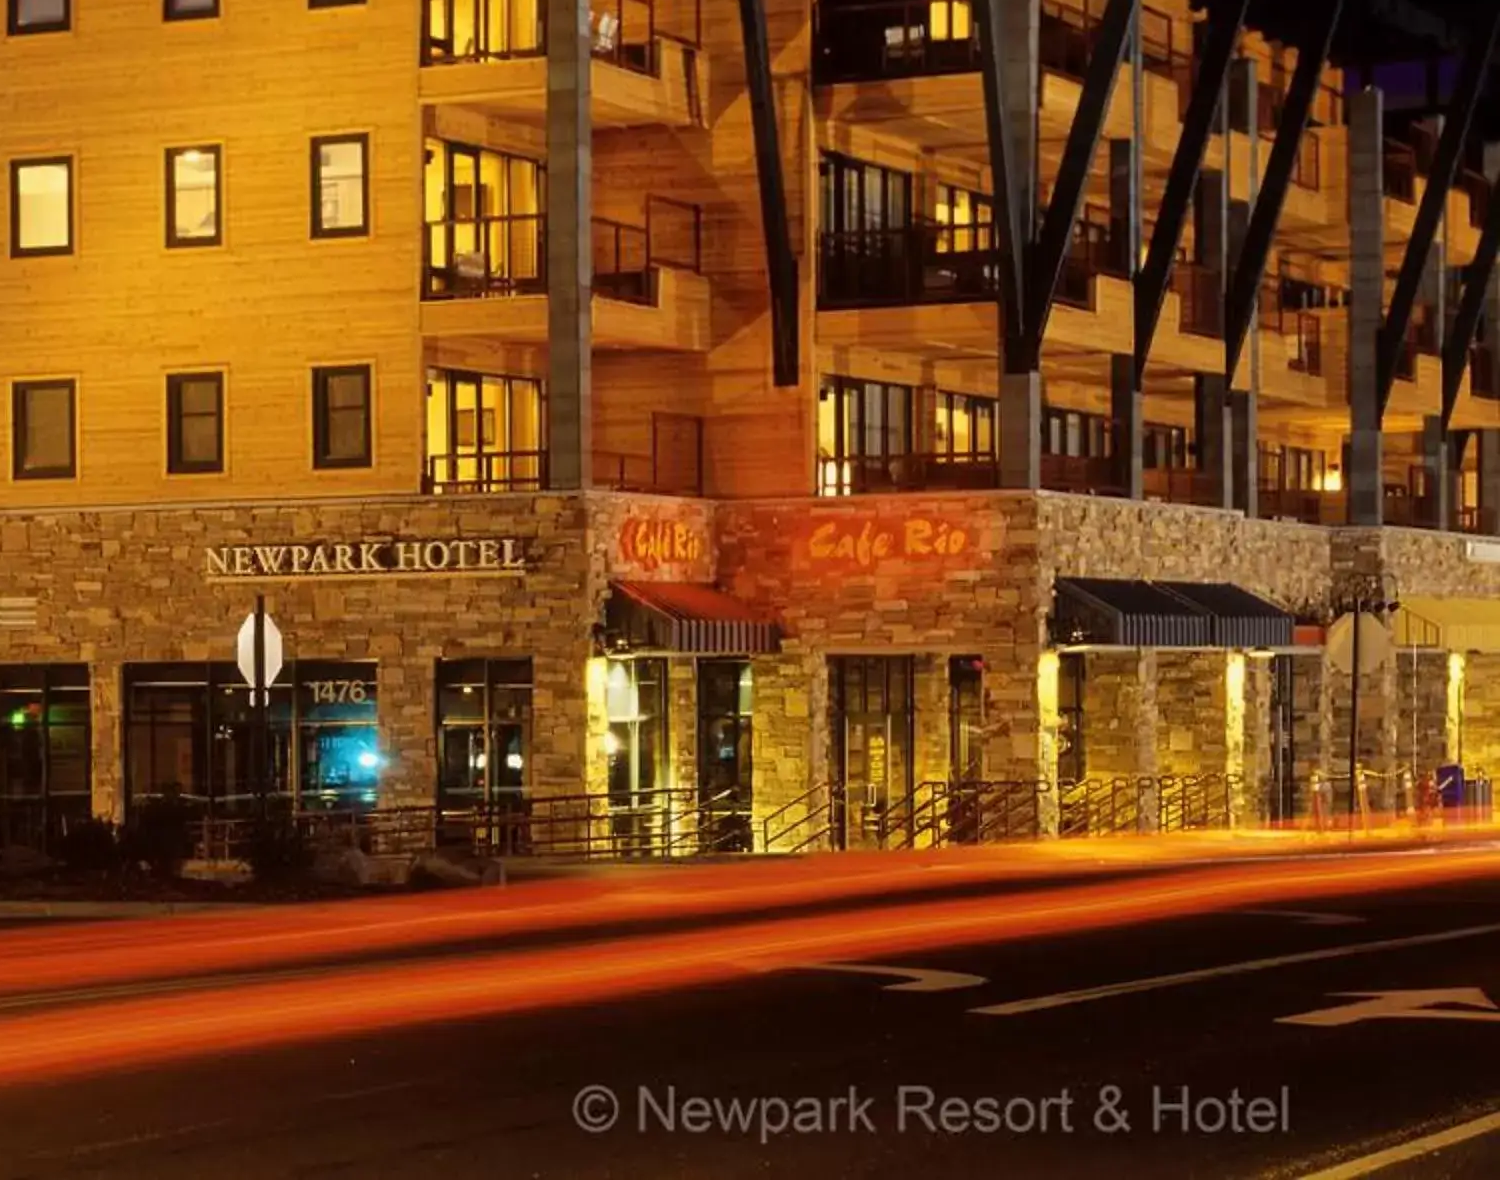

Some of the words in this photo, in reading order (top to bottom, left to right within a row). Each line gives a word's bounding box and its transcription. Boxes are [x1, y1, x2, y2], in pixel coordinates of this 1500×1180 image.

[904, 519, 966, 555] Rio
[204, 544, 384, 575] NEWPARK
[399, 539, 526, 570] HOTEL
[311, 680, 367, 704] 1476
